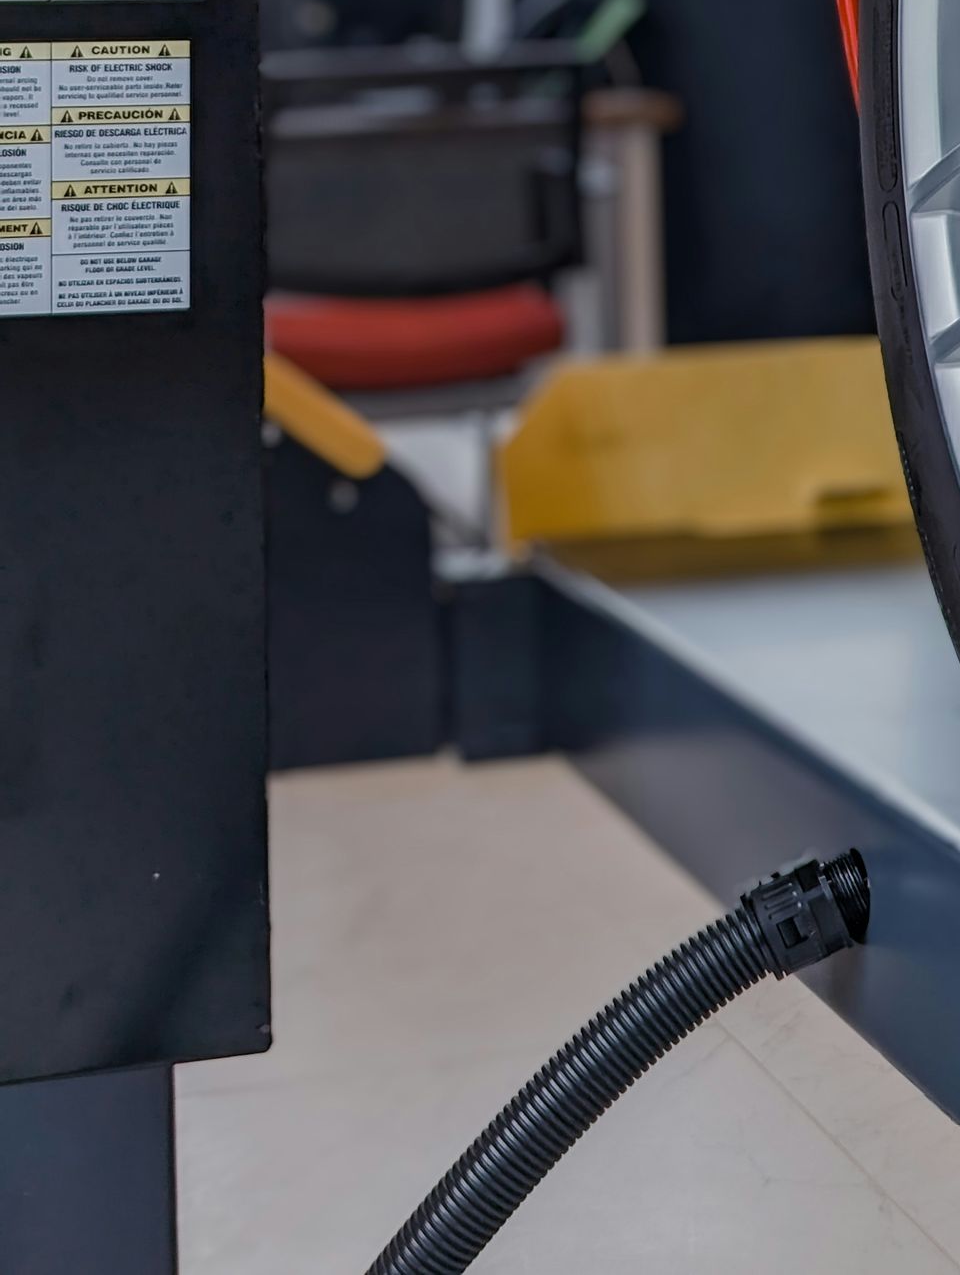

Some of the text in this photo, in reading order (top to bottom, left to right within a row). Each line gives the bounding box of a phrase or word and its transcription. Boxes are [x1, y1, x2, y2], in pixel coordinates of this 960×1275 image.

[92, 45, 150, 55] CAUTION
[69, 63, 172, 73] RISK OF ELECTRIC SHOCK
[78, 108, 163, 120] PRECAUCIÓN
[54, 126, 188, 138] RIESGO DE DESCARGA ELÉCTRICA
[0, 147, 27, 157] OSIÓN
[84, 184, 158, 194] ATTENTION
[61, 200, 180, 212] RISQUE DE CHOC ÉLECTRIQUE
